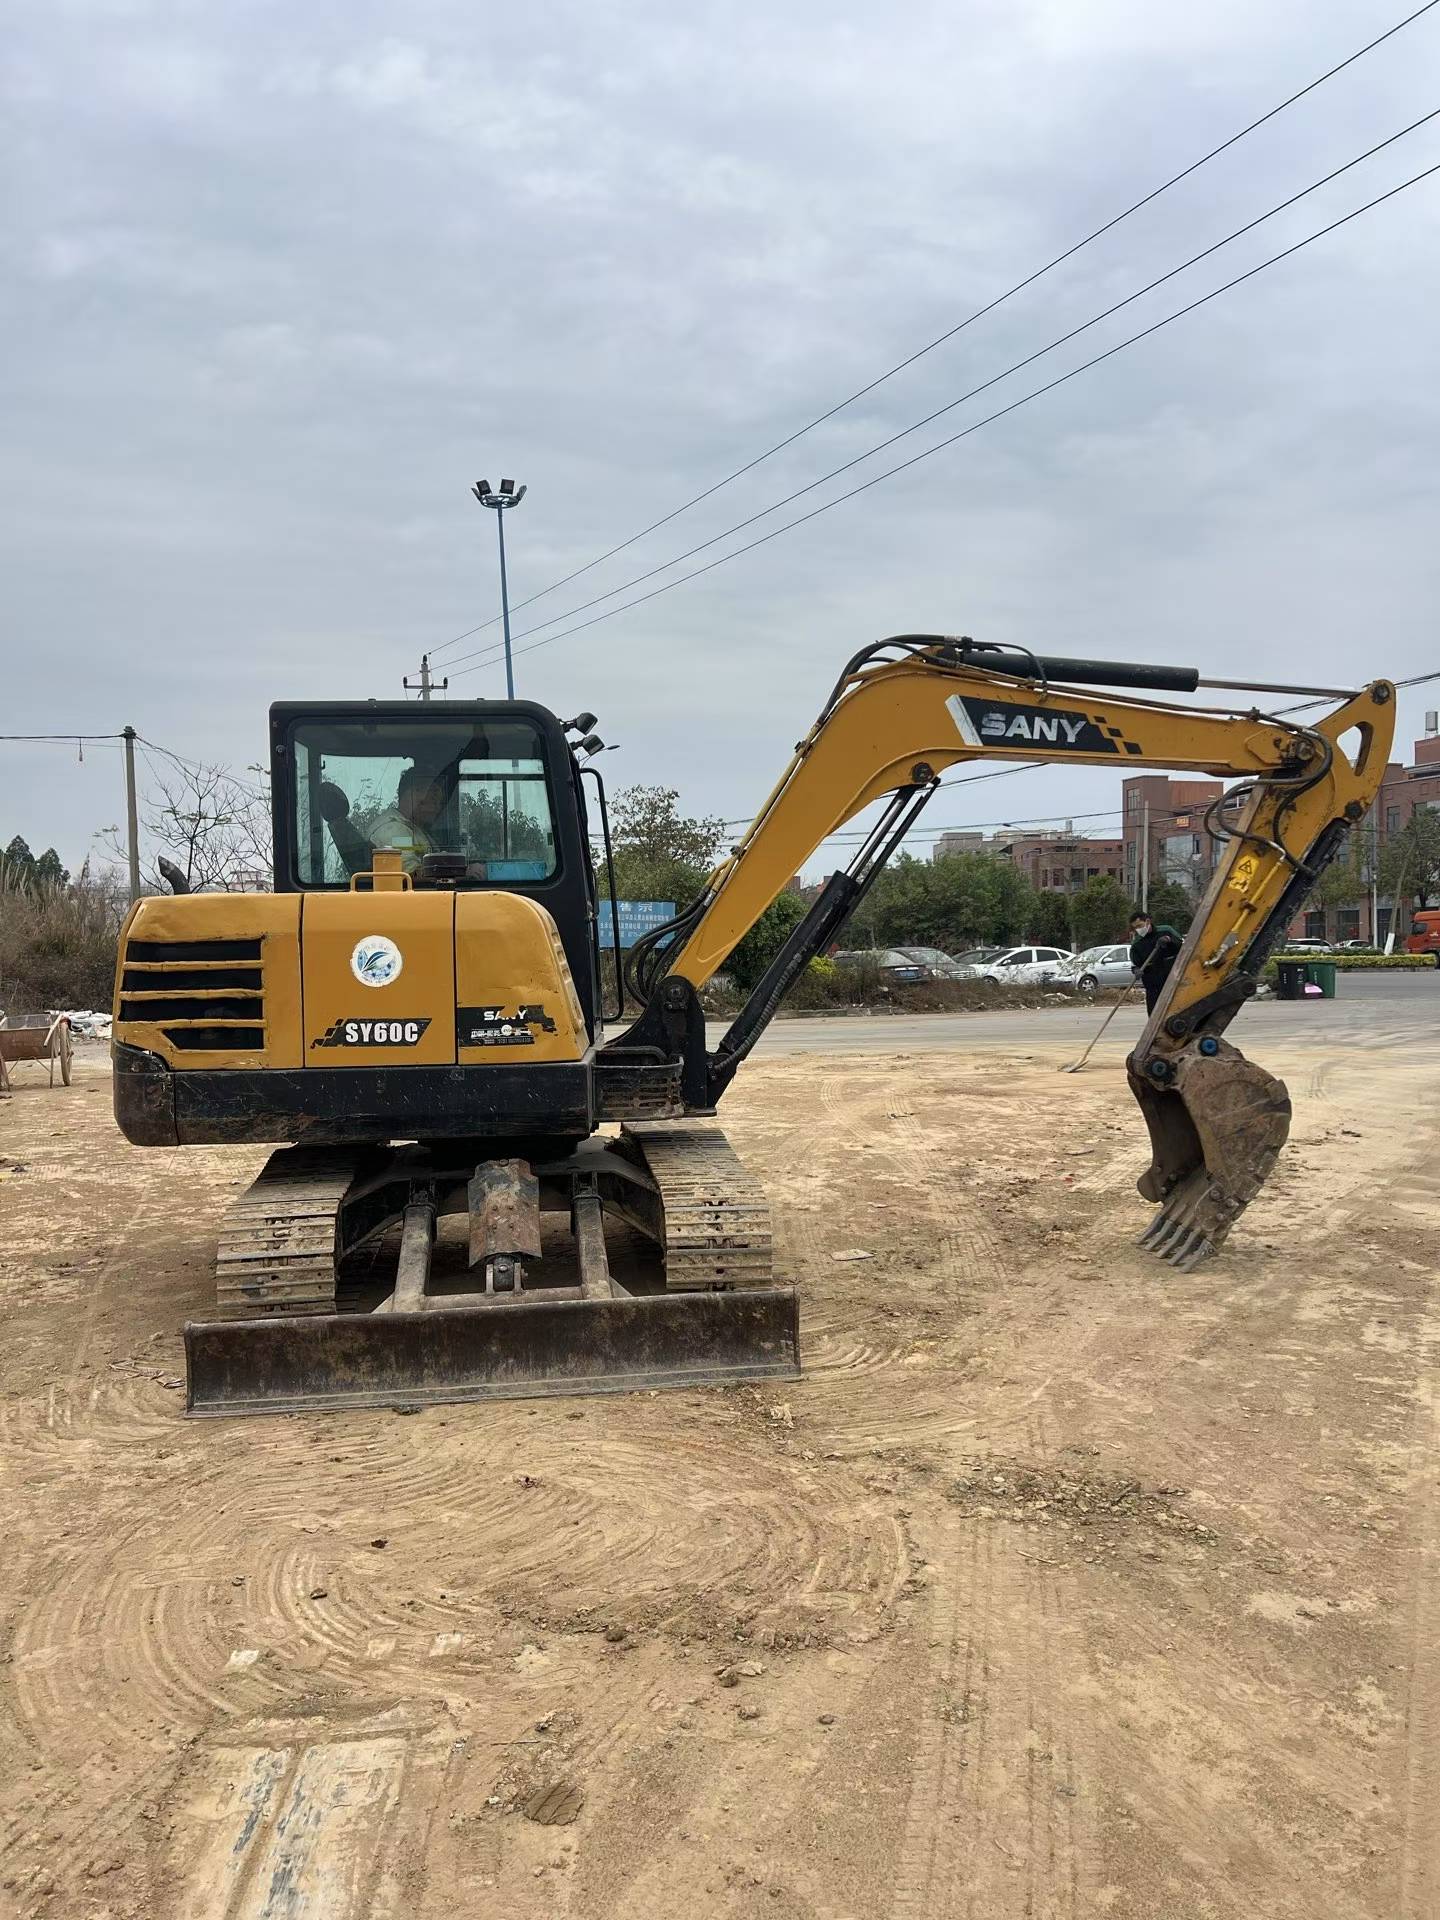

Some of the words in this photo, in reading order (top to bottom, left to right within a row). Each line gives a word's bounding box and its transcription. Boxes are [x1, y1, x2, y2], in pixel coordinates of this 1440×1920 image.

[980, 712, 1087, 743] SANY
[483, 1009, 528, 1021] SAY
[345, 1022, 418, 1043] SY60C
